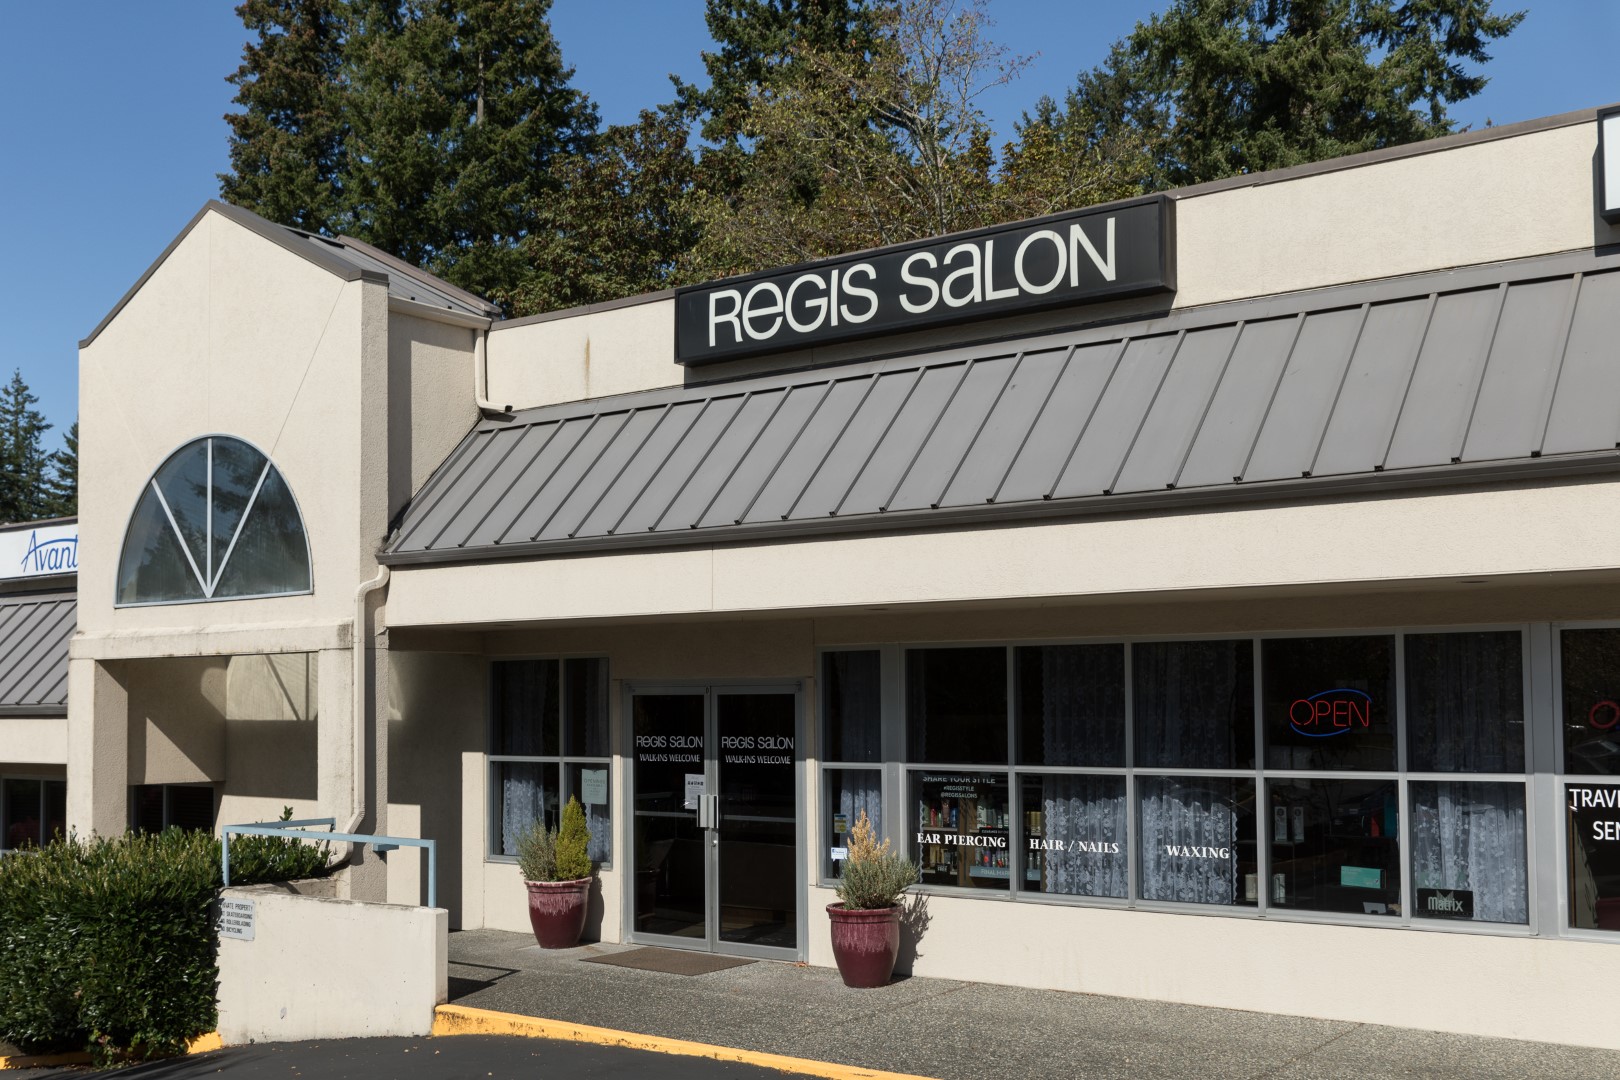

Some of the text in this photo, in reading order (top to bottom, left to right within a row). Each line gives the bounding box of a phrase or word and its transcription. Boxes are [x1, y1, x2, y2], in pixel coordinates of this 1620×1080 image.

[1290, 698, 1371, 728] OPEN
[639, 753, 701, 763] WALK-INS WELCOME
[725, 754, 791, 765] WALK-INS WELCOME
[1569, 788, 1620, 807] TRAV
[917, 832, 1007, 848] EAR PIERCING
[1029, 838, 1064, 851] HAIR
[1078, 840, 1119, 855] NAILS
[1166, 844, 1230, 860] WAXING
[235, 903, 253, 912] PROPERTY
